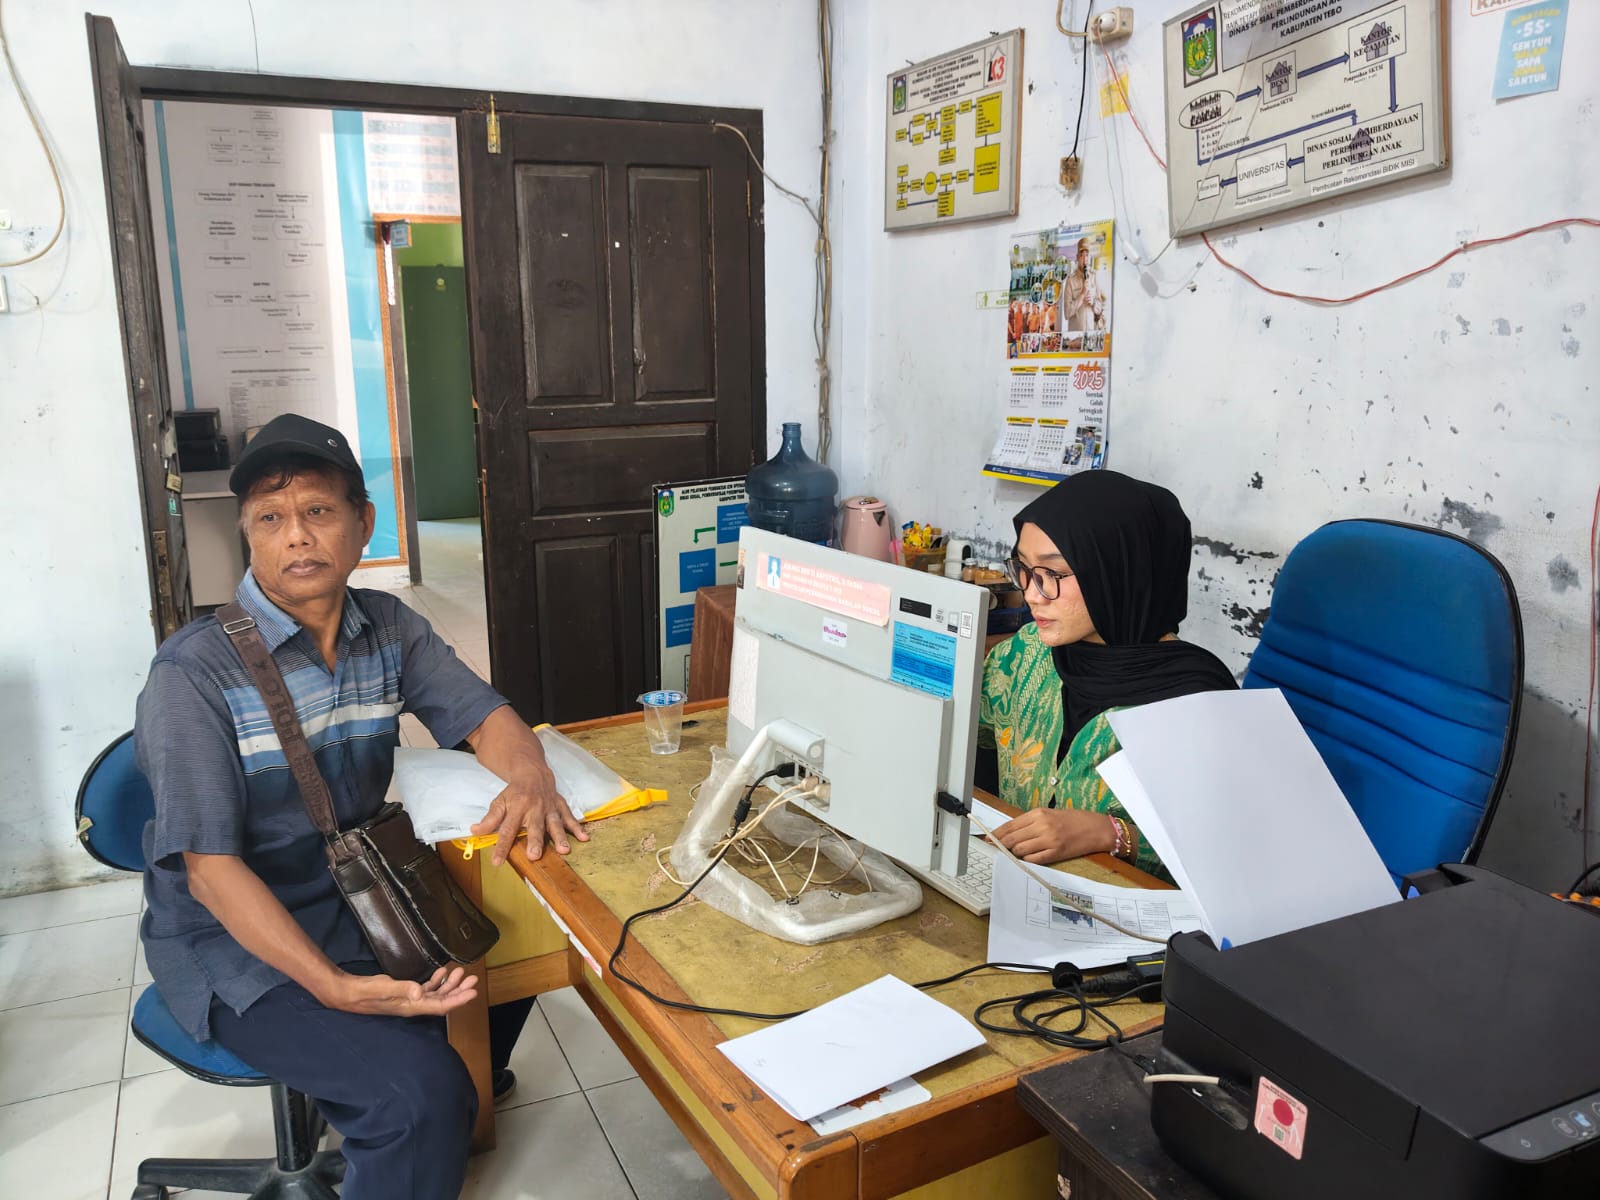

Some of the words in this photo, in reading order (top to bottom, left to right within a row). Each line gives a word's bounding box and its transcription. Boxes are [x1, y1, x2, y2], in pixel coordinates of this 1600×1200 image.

[1271, 0, 1328, 30] PERLINDUNGAN
[1280, 14, 1322, 37] KABUPATEN
[1321, 6, 1342, 20] TEBO
[1229, 22, 1250, 37] DINAS
[1360, 25, 1393, 44] KANTOR
[1353, 33, 1401, 58] KECAMATAN
[1265, 65, 1293, 81] KANTOR
[1271, 78, 1288, 89] DESA
[1307, 142, 1328, 154] DINAS
[1376, 132, 1393, 144] DAN
[1322, 148, 1379, 170] PERLINDUNGAN
[1379, 140, 1403, 154] ANAK
[1238, 160, 1285, 181] UNIVERSITAS
[1073, 370, 1105, 391] 2025
